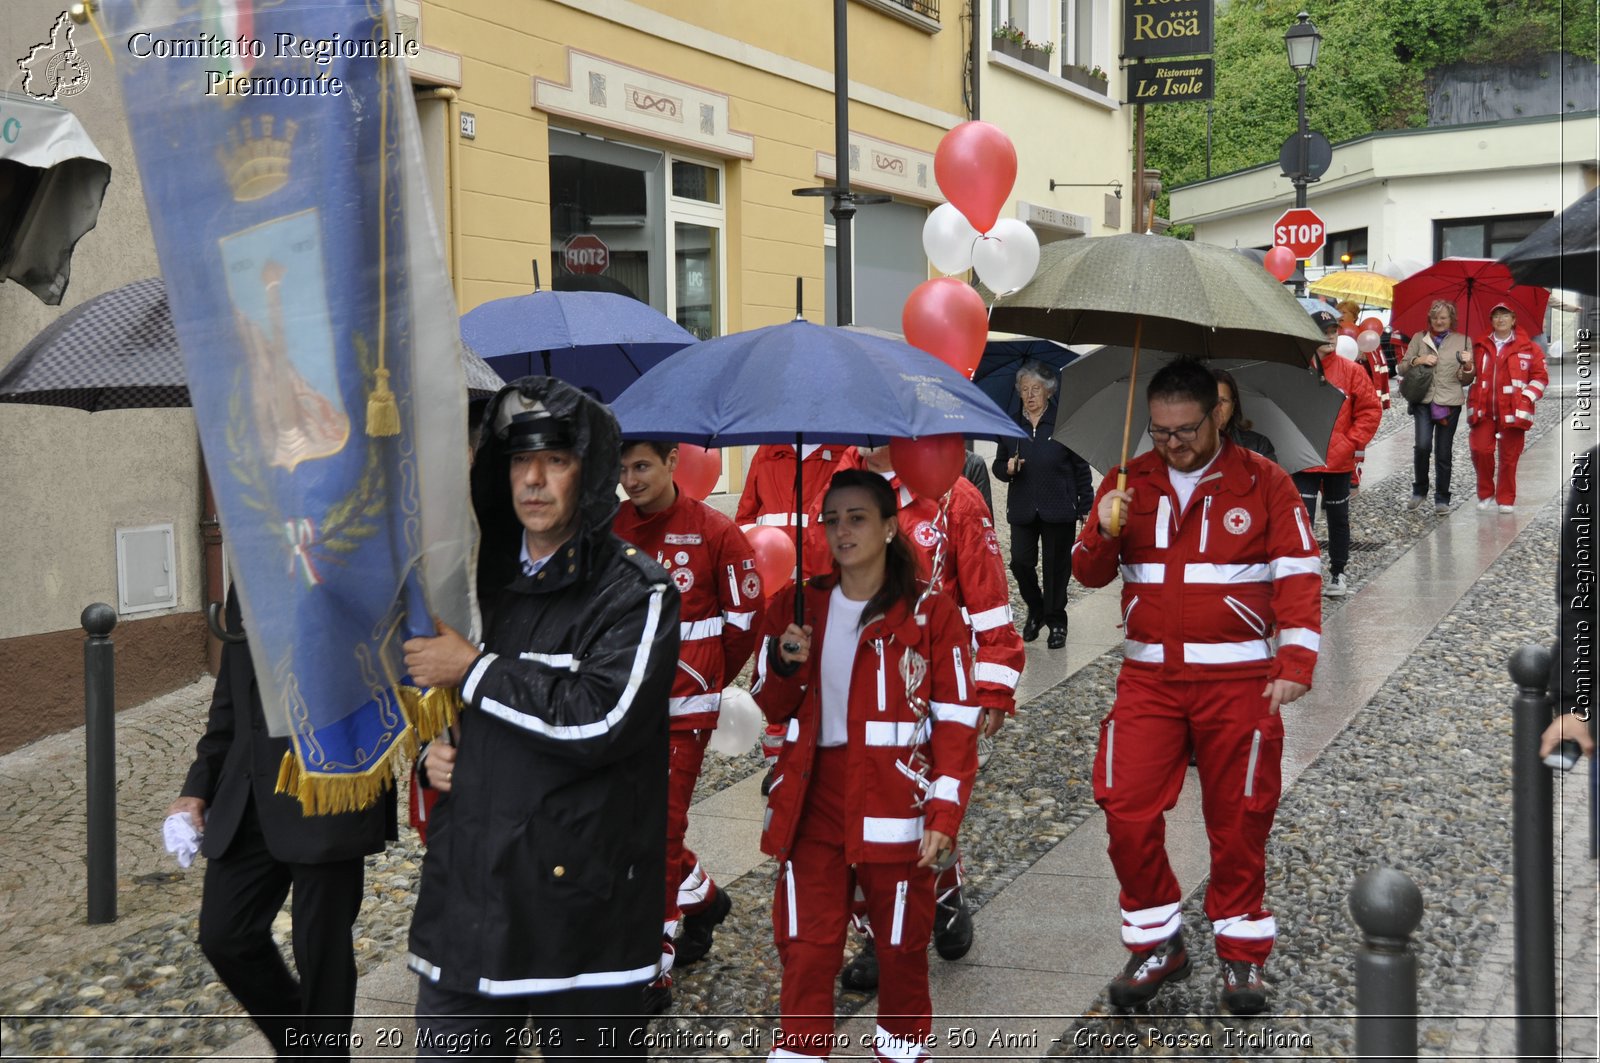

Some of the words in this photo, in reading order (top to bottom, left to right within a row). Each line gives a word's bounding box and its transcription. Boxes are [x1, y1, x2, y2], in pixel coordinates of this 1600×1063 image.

[1133, 14, 1201, 40] Rosa
[1155, 67, 1204, 78] Ristorante
[1135, 80, 1158, 97] Le
[1162, 77, 1203, 96] Isole
[462, 117, 474, 134] 21
[1276, 224, 1323, 245] STOP
